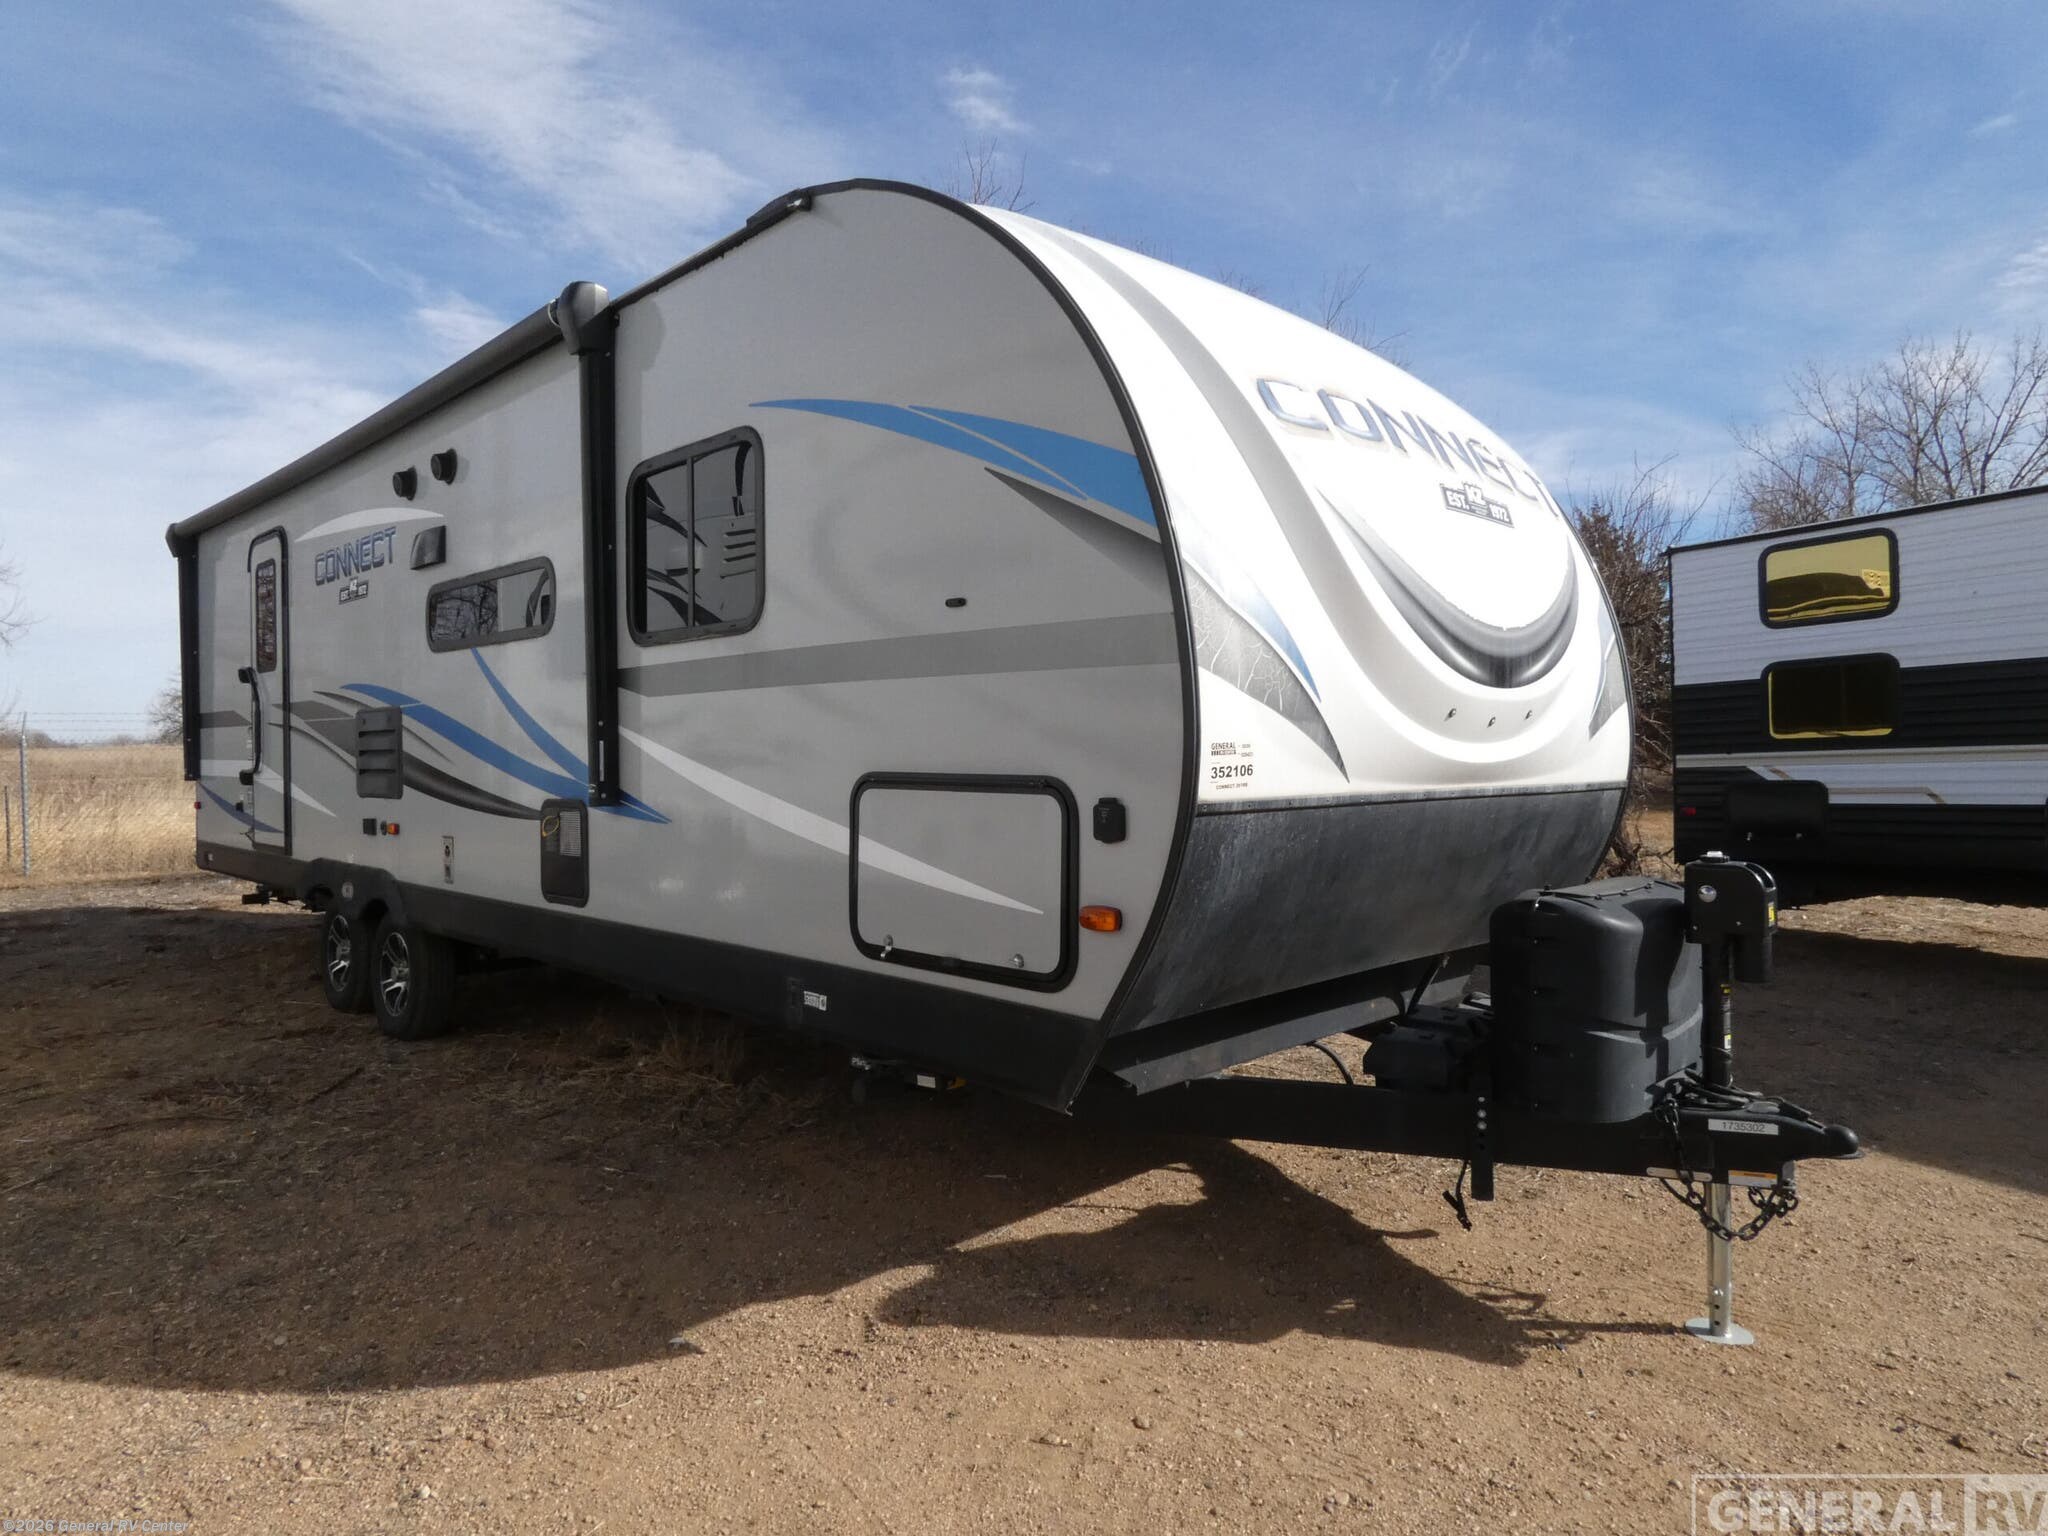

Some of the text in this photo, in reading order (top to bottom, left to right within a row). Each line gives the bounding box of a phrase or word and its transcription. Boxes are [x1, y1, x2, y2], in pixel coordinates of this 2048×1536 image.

[1256, 377, 1559, 519] CONNECT
[315, 526, 397, 587] CONNECT
[1210, 764, 1254, 779] 352106
[1721, 1121, 1766, 1133] 1735302
